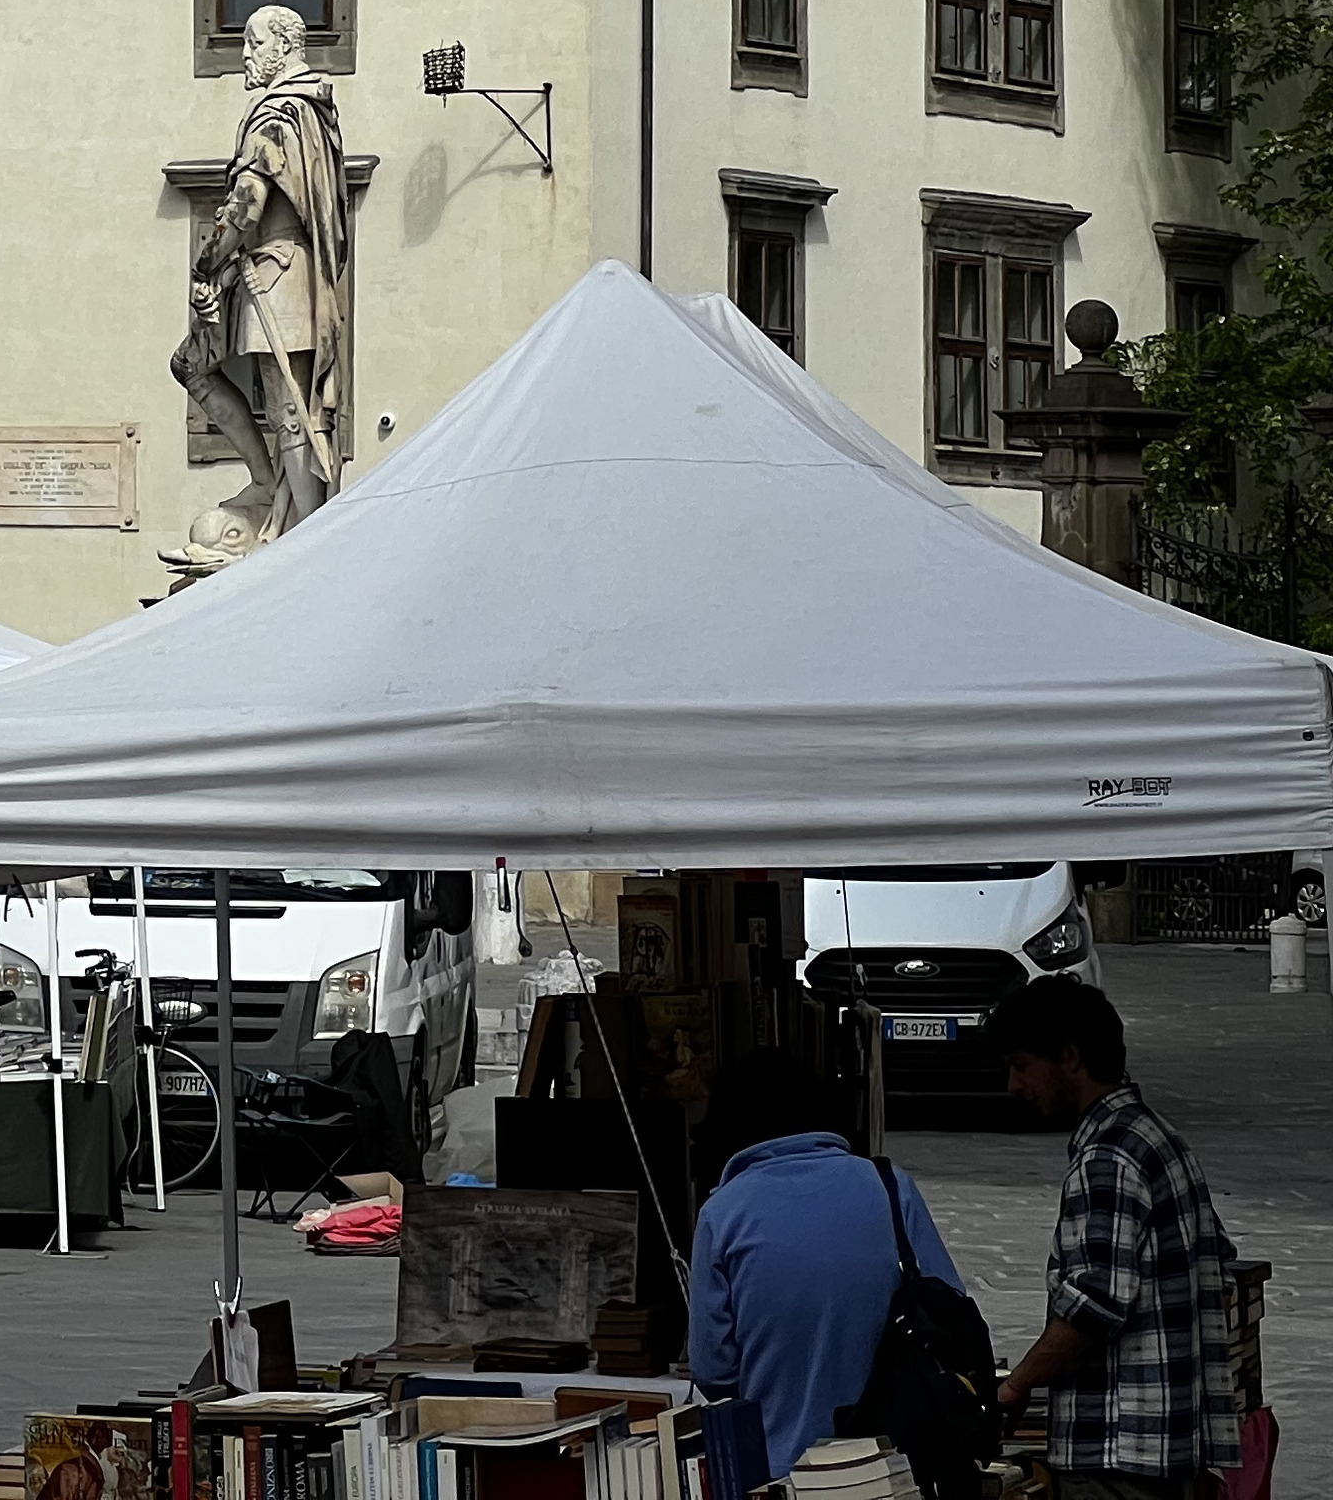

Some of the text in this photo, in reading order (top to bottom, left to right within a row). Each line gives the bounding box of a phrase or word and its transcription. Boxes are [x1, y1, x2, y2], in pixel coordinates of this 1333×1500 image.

[1088, 776, 1172, 796] RAY BOT
[473, 1204, 522, 1215] ETRURIA
[294, 1461, 306, 1500] ROMA
